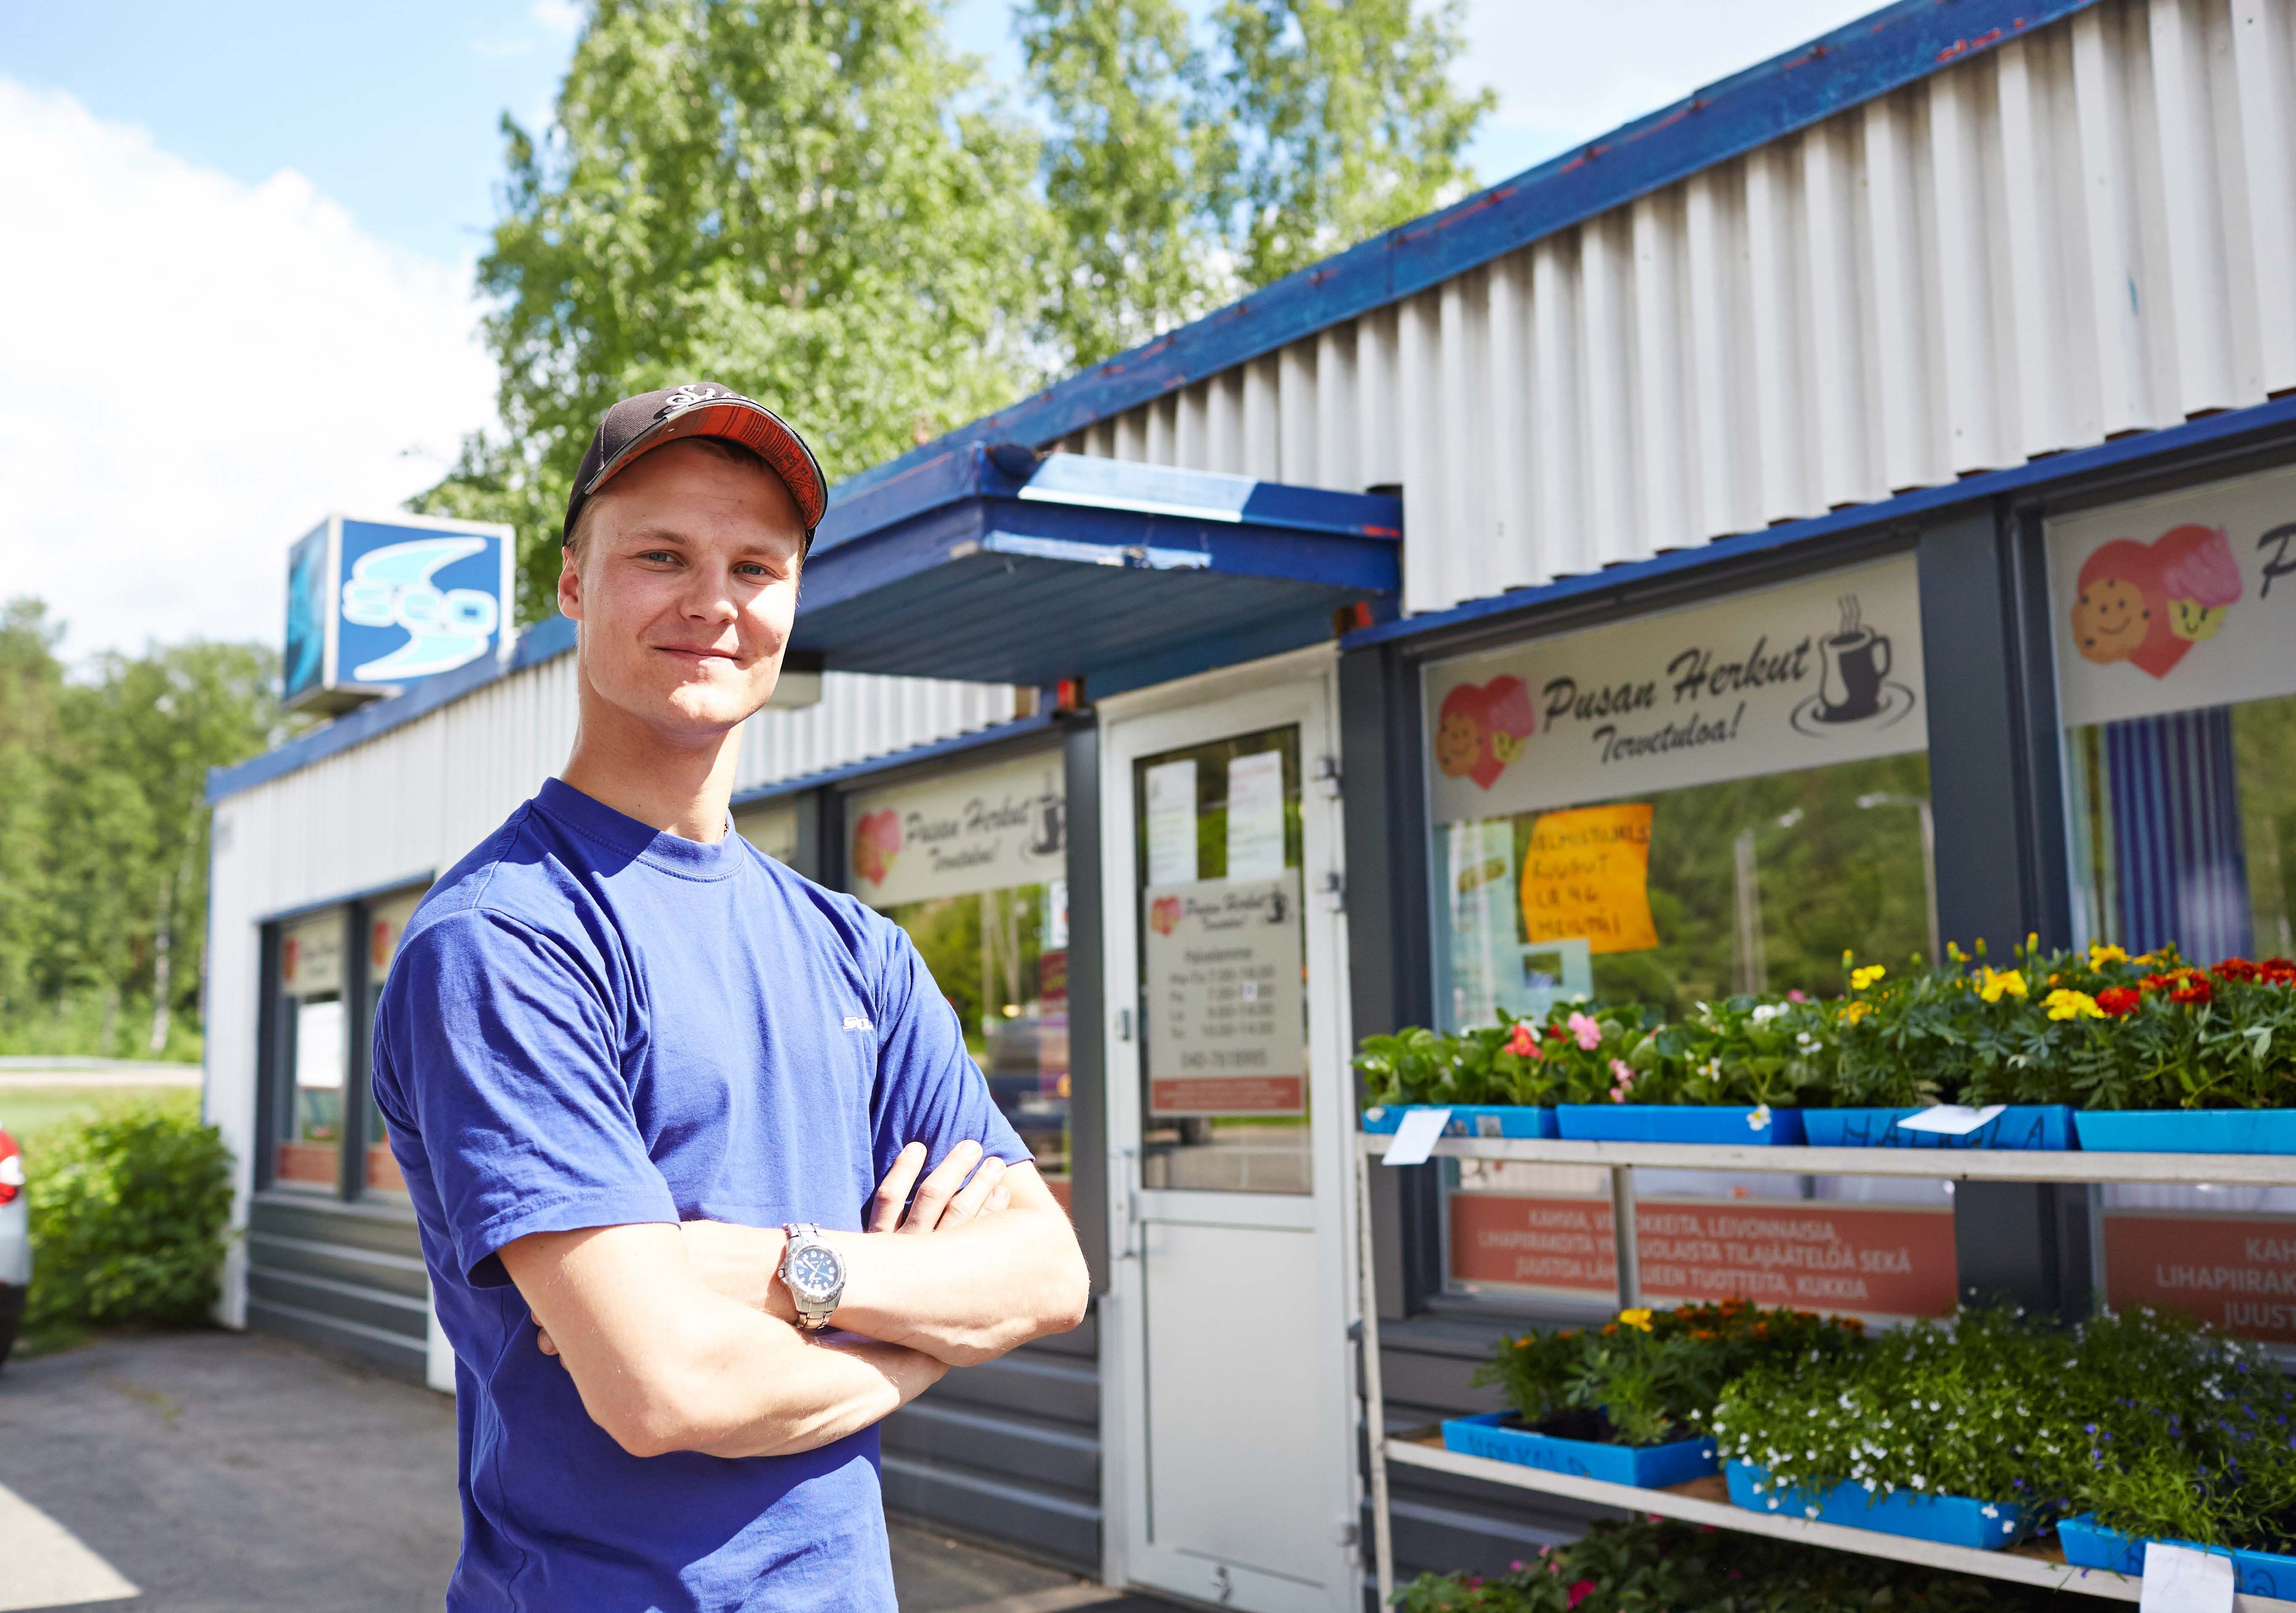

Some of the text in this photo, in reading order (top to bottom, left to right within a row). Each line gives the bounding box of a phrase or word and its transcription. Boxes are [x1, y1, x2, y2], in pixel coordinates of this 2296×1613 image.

[1543, 635, 1811, 733] Pusan Herkut
[1593, 700, 1746, 765] Tervetuloa!
[1859, 1246, 1912, 1274] SEKÄ
[1796, 1277, 1869, 1300] KUKKIA
